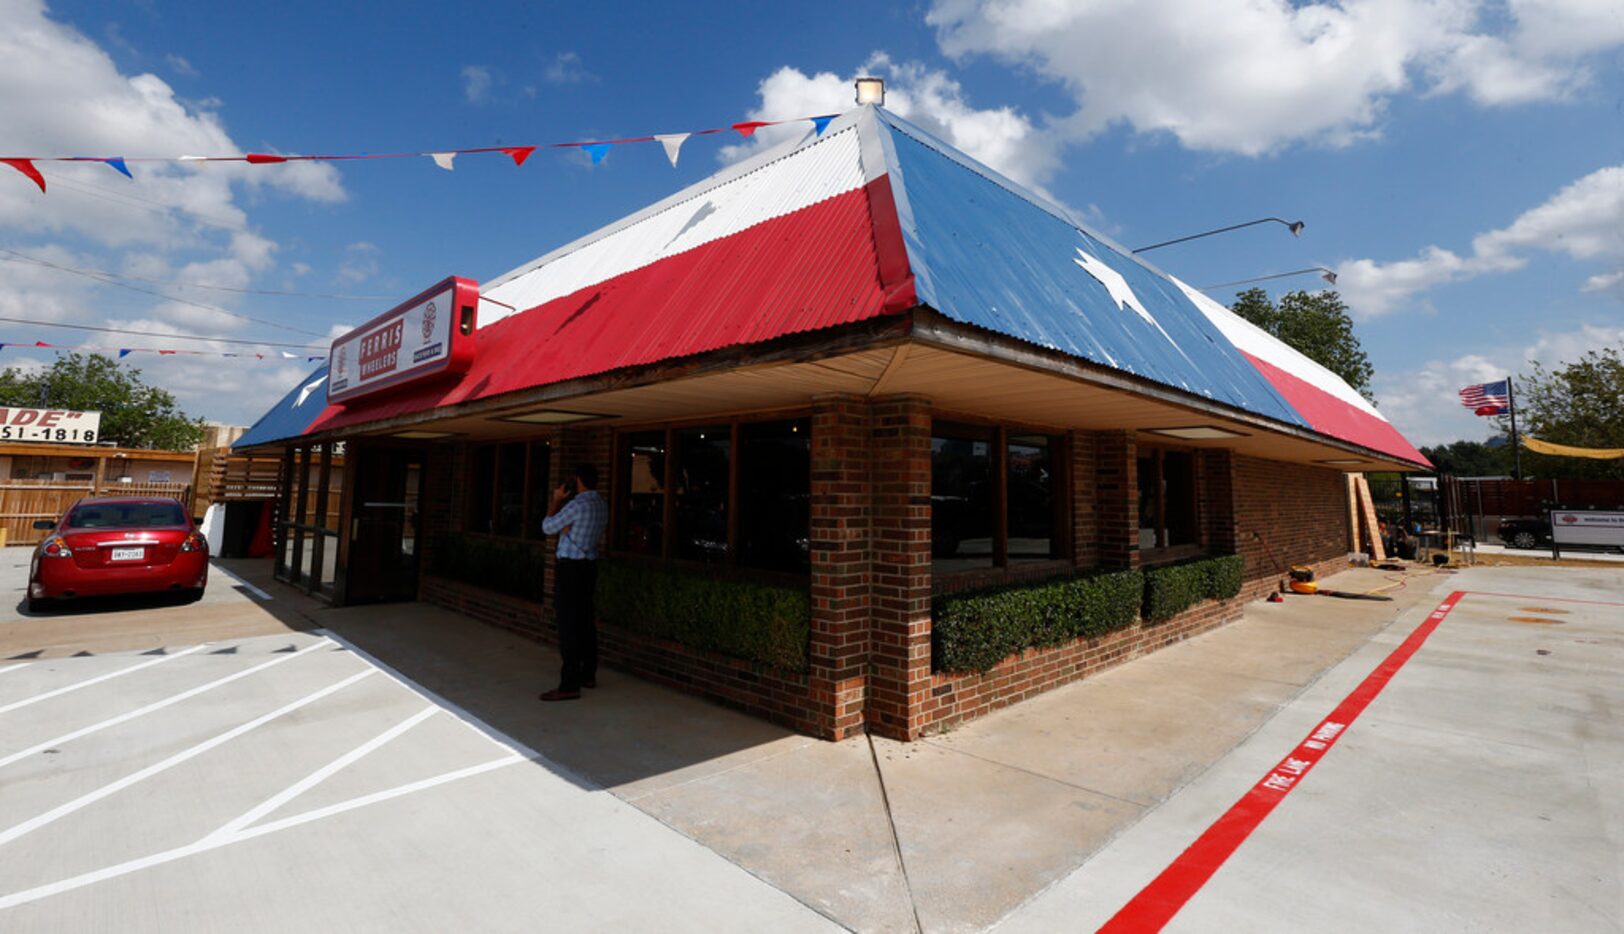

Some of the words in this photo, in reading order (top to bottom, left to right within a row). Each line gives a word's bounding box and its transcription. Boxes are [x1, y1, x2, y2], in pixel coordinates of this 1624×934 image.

[361, 324, 401, 360] FERRIS
[362, 351, 396, 376] WHEELERS
[1, 426, 95, 441] 51-1818
